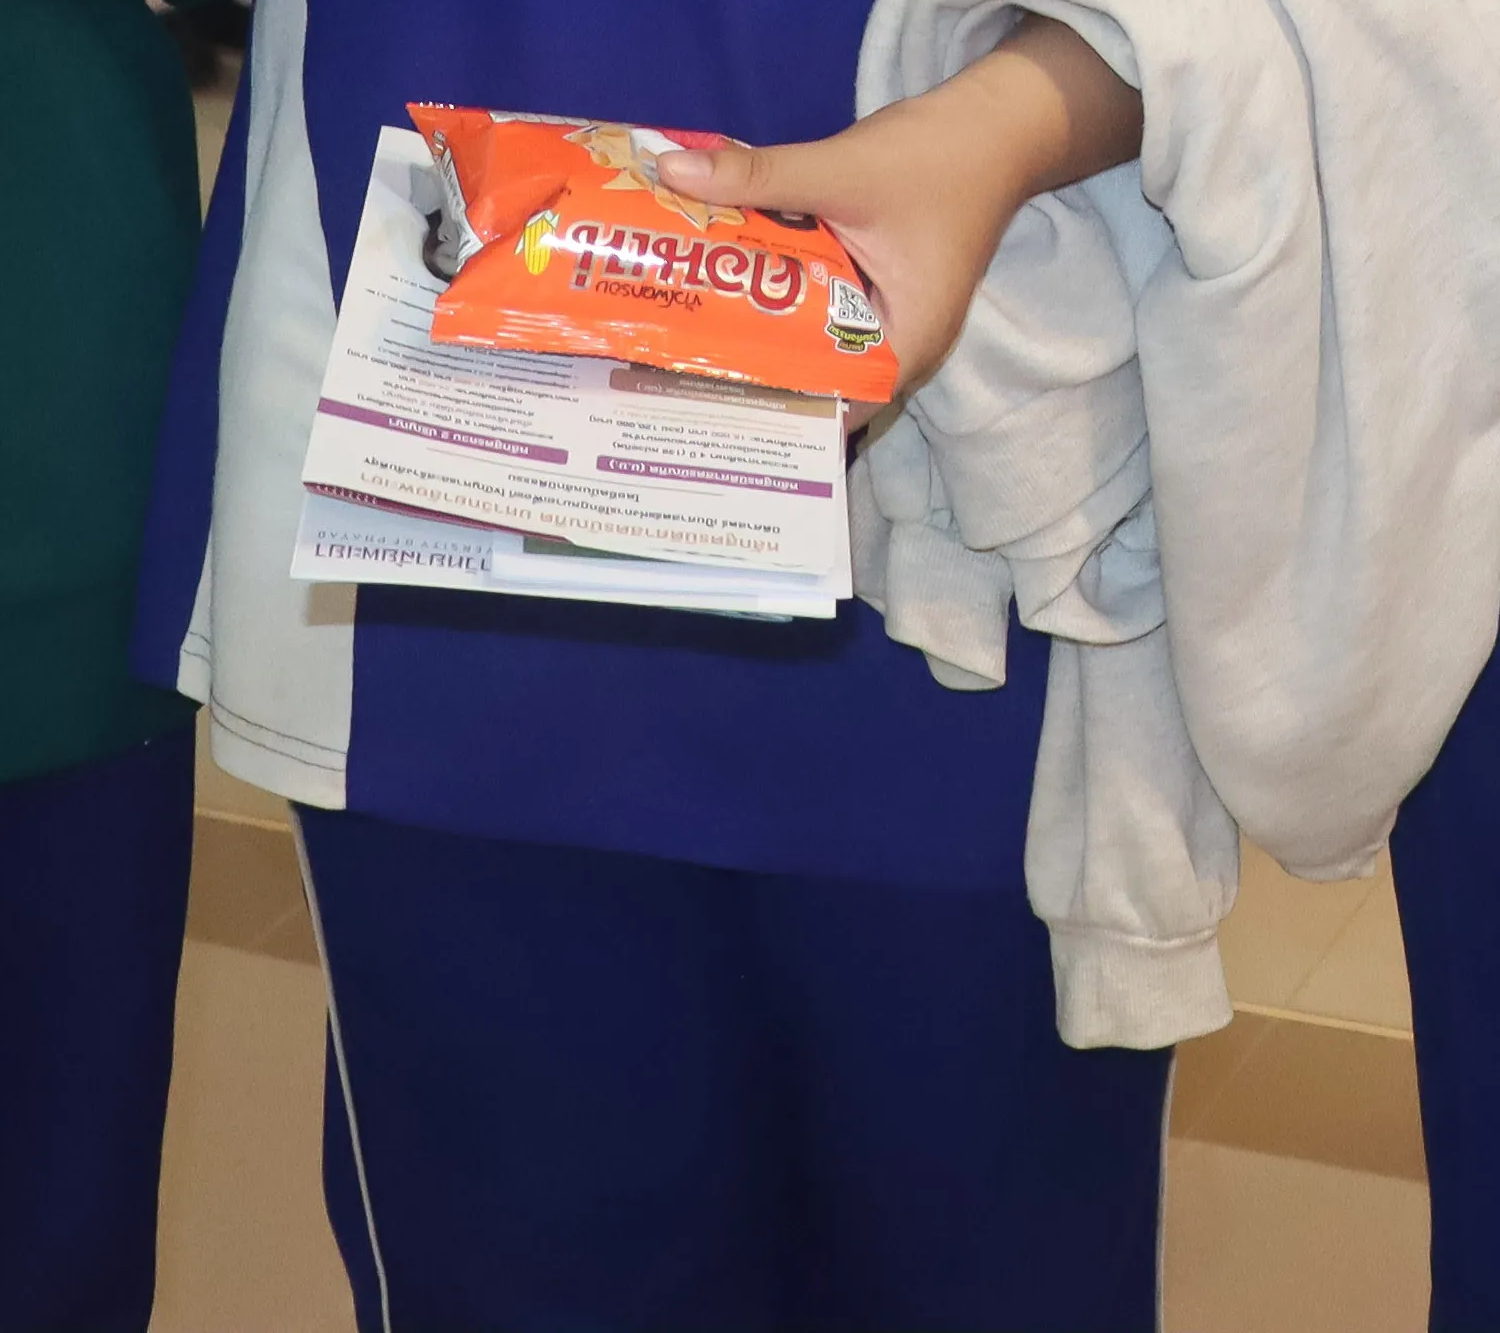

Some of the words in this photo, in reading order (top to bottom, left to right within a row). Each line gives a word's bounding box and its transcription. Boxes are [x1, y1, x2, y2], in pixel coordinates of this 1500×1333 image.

[358, 471, 532, 518] มหาวิทยาลัยพะเยา
[538, 511, 779, 554] หลักสูตรนิติศาสตรบัณฑิต
